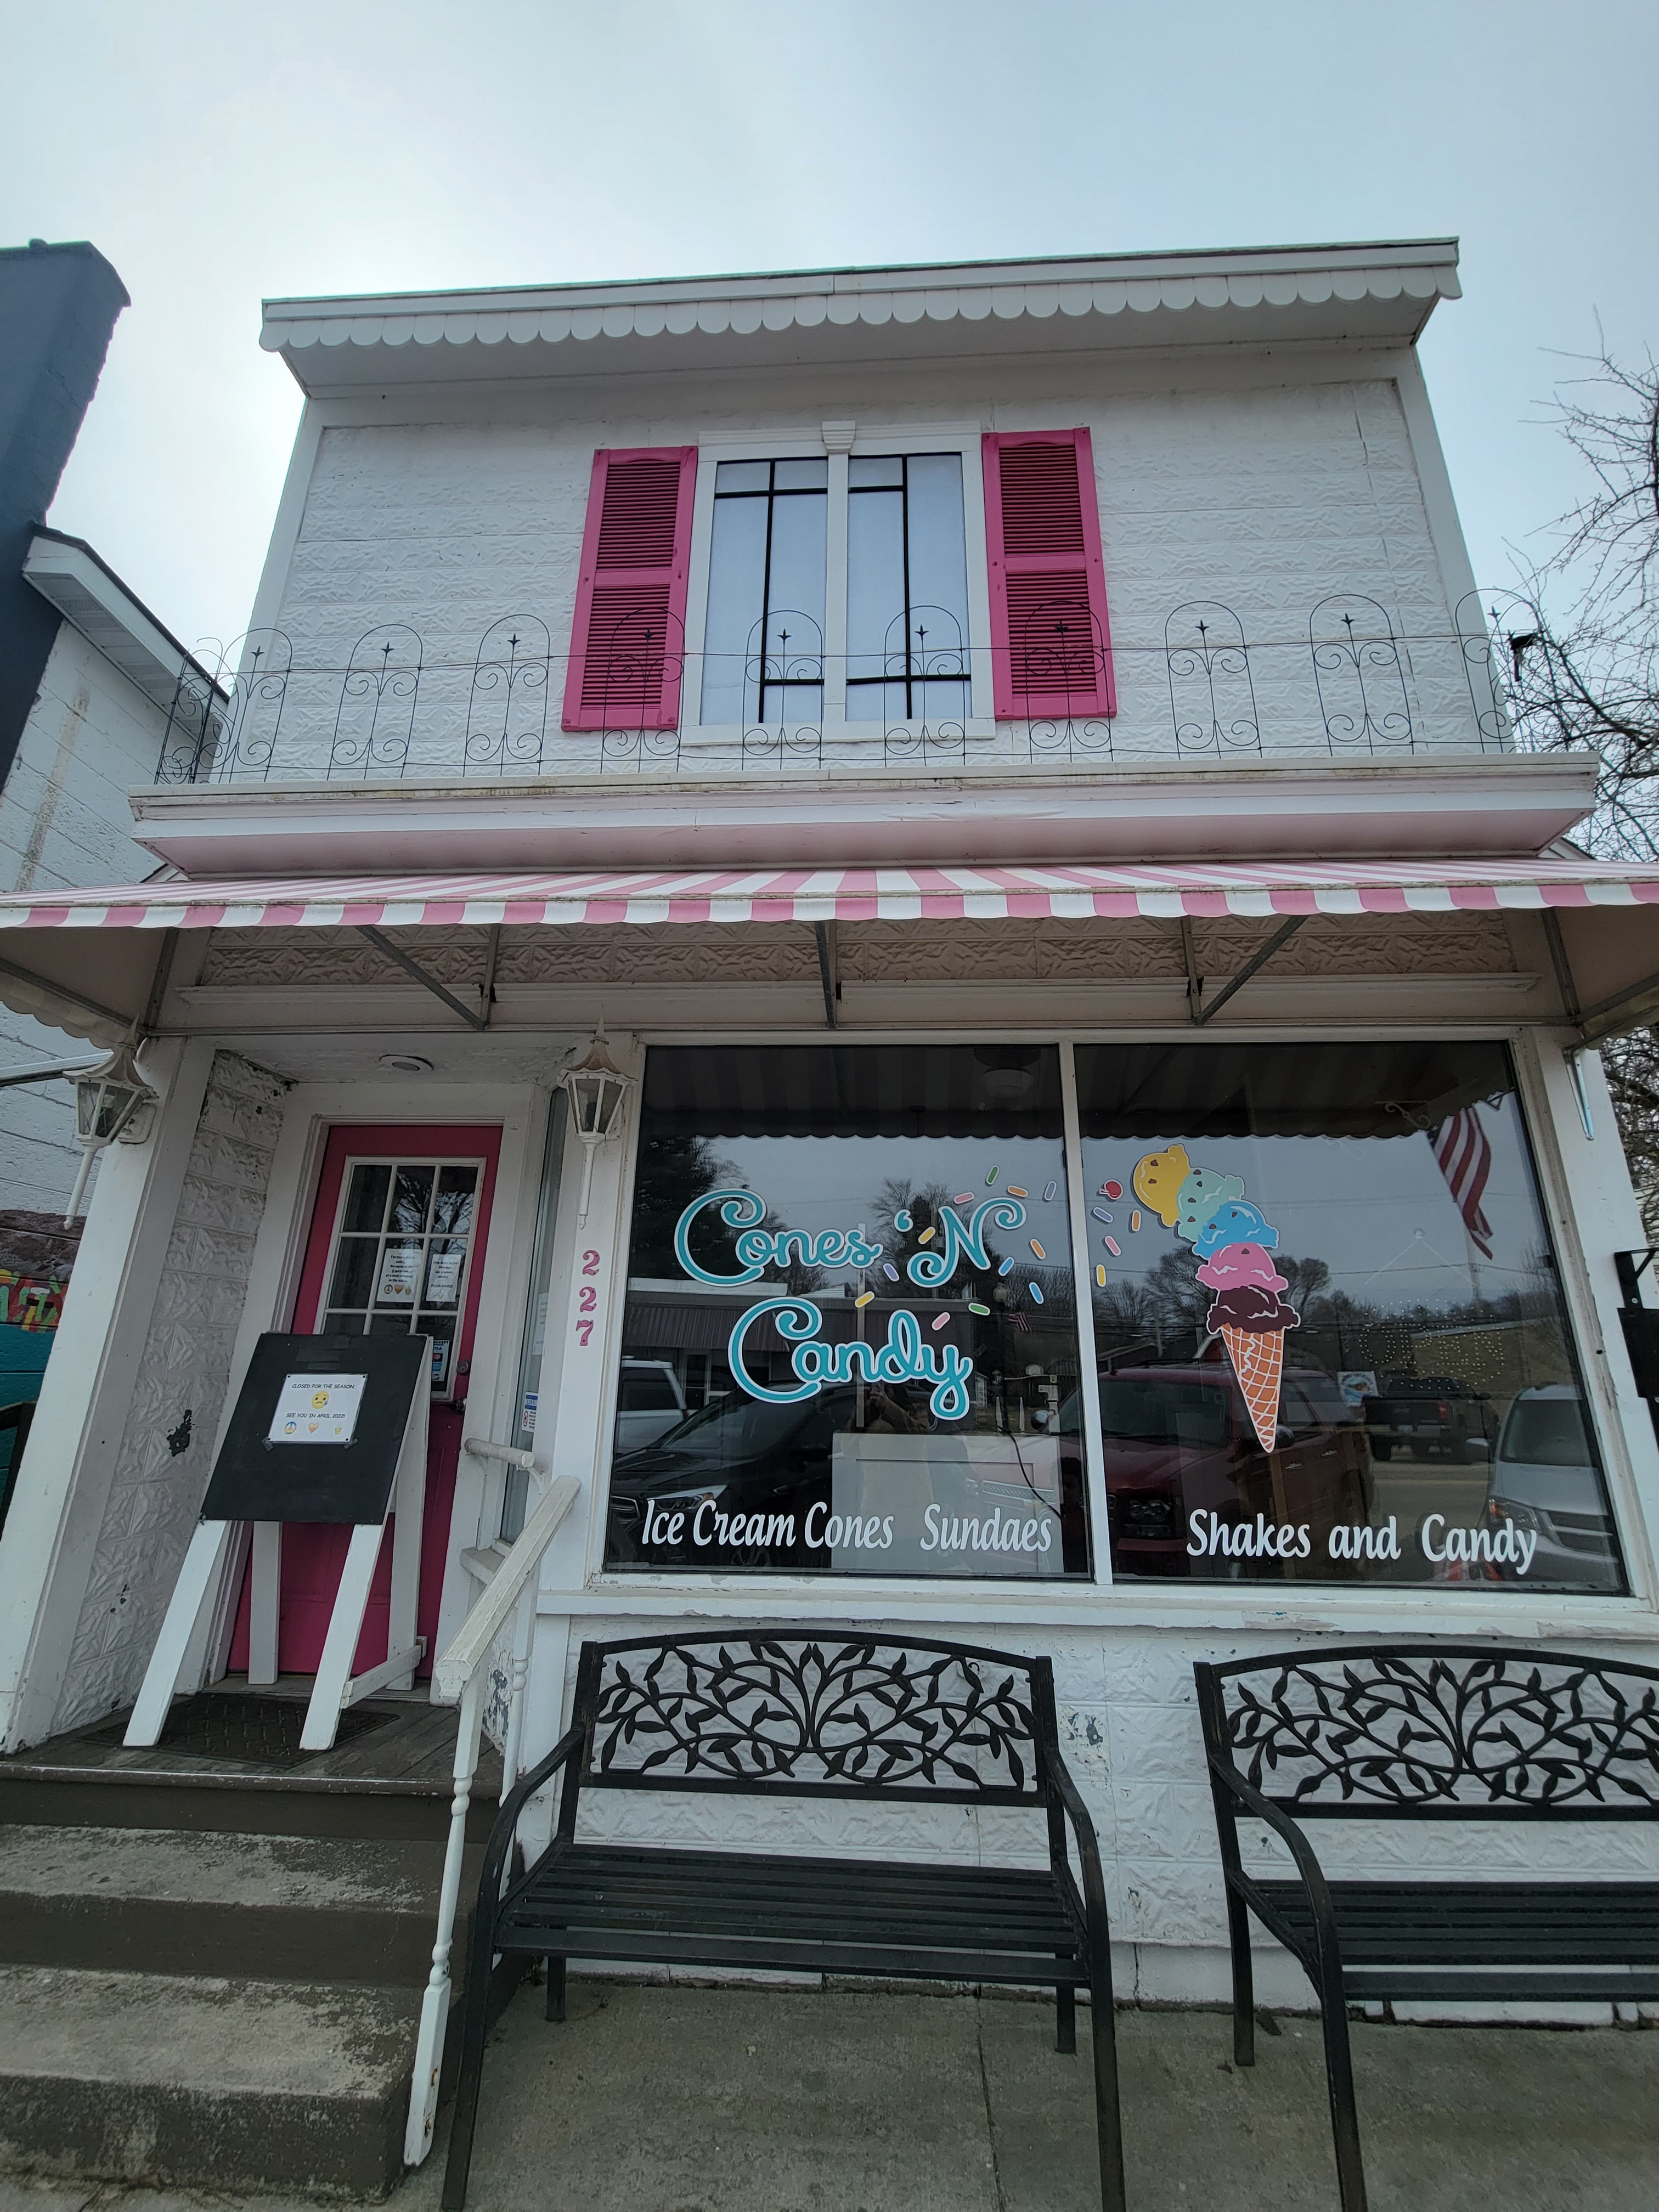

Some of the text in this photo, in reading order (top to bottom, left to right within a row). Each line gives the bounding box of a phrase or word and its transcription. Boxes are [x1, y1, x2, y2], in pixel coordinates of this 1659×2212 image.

[674, 1188, 883, 1286] Cones
[729, 1297, 973, 1420] Candy
[1358, 1322, 1505, 1367] OPEN
[642, 1499, 1052, 1552] Ice Cream Cones Sundaes
[1187, 1509, 1537, 1575] Shakes and Candy
